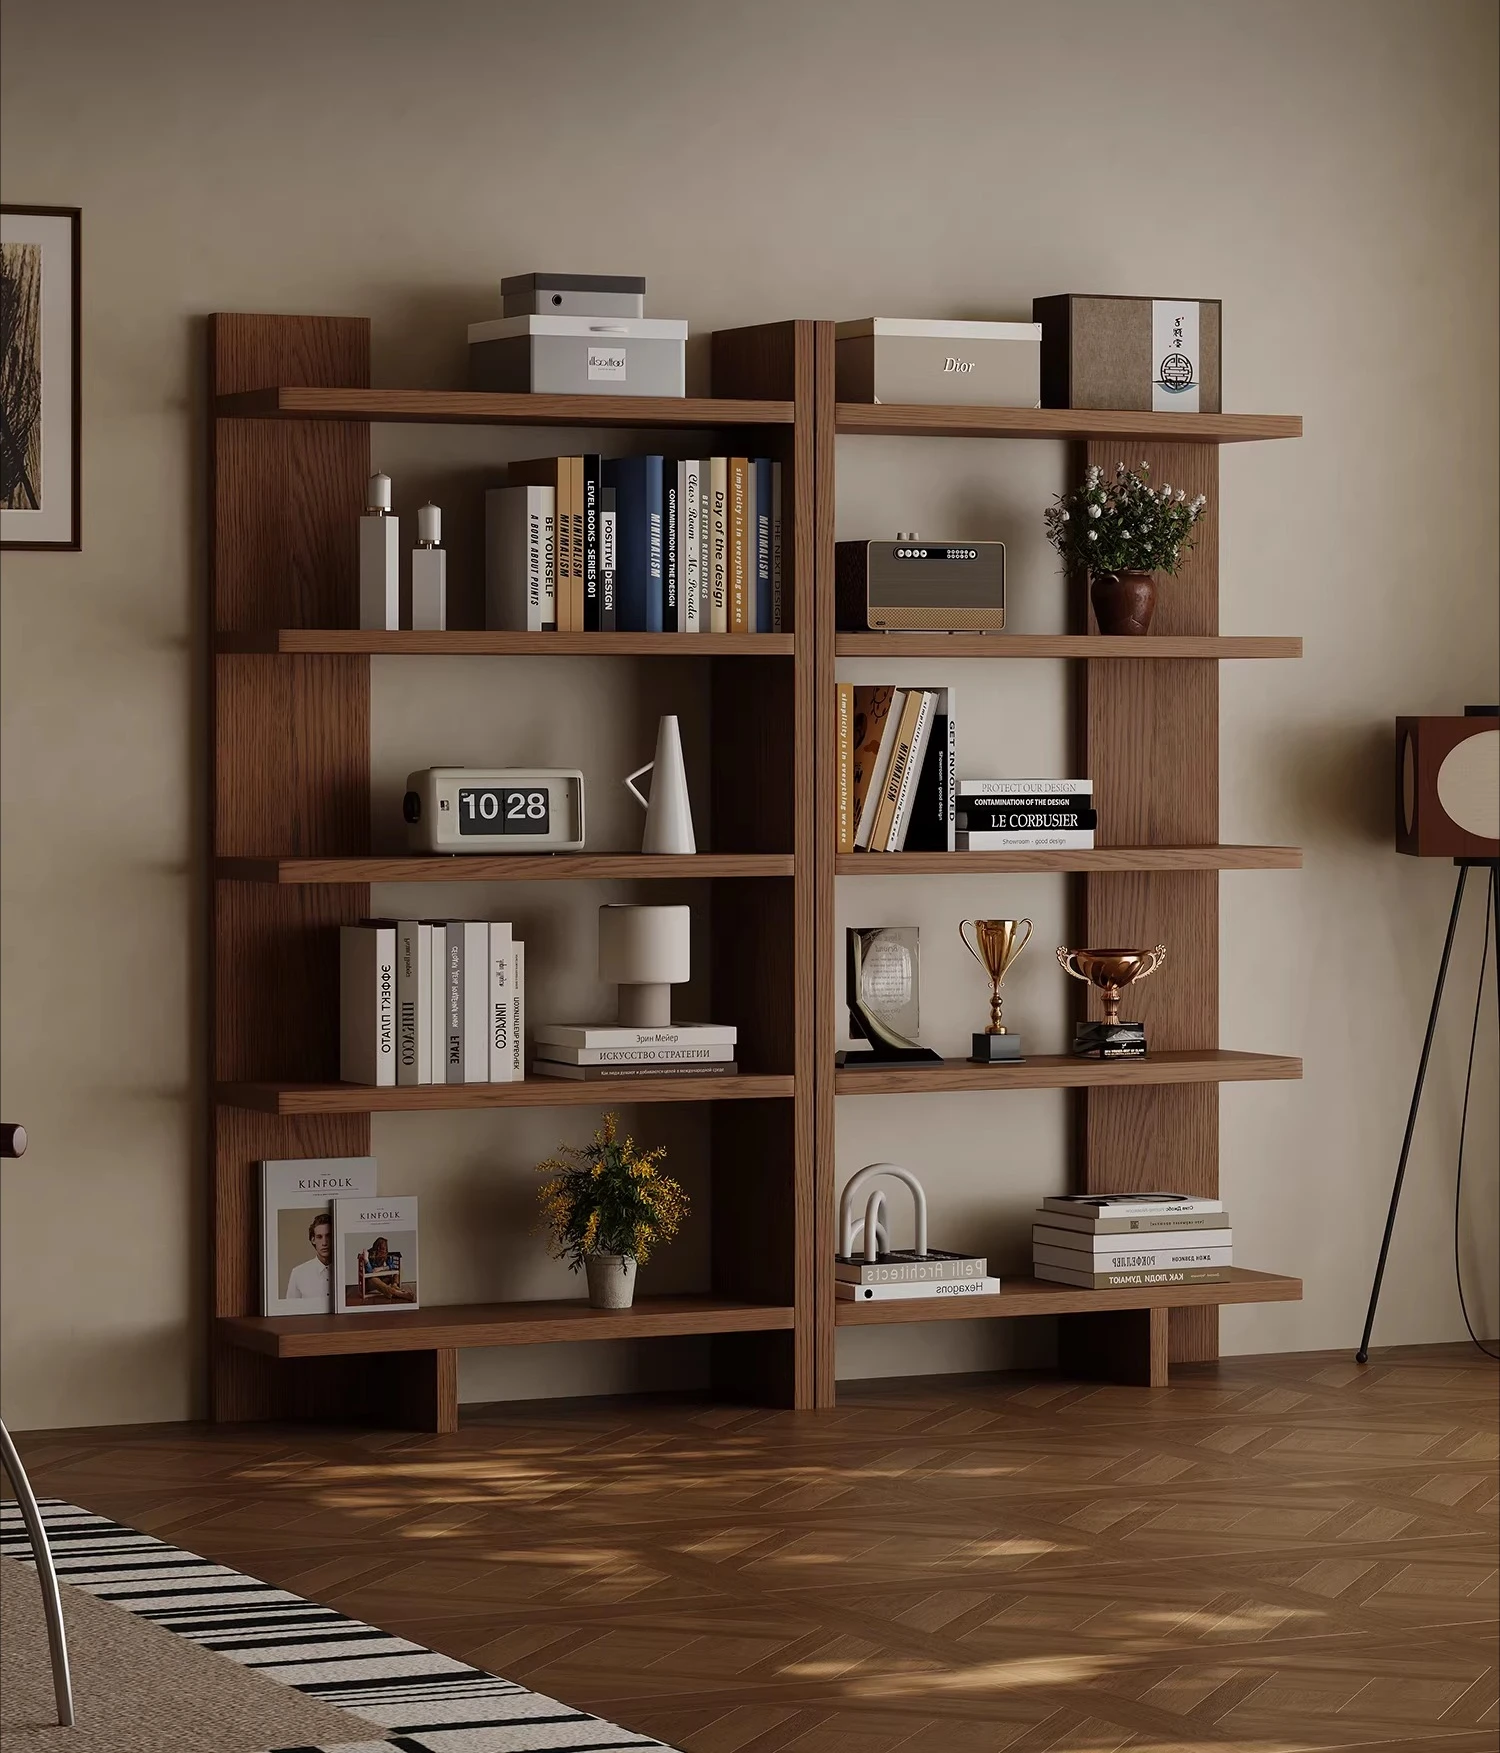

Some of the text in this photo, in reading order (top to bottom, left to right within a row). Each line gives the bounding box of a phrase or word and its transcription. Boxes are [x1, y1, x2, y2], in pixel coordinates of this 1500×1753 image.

[944, 358, 975, 372] Dior
[688, 474, 697, 504] Class
[702, 495, 708, 505] BE
[546, 516, 553, 532] BE
[688, 507, 697, 540] Room
[735, 528, 741, 537] in
[560, 514, 569, 578] MINIMALISM
[573, 514, 582, 578] MINIMALISM
[651, 514, 660, 578] MINIMALISM
[713, 491, 724, 608] Day of the design
[759, 516, 768, 579] MINIMALISM
[669, 552, 676, 561] OF
[688, 554, 697, 575] Ms.
[688, 578, 697, 620] Posada
[735, 593, 741, 605] we
[914, 701, 927, 743] simplicity
[841, 752, 848, 760] in
[909, 755, 915, 764] in
[887, 742, 908, 802] MINIMALISM
[899, 766, 912, 811] everything
[982, 783, 1076, 793] PROTECT OUR DESIGN
[462, 793, 498, 819] 10
[507, 793, 546, 819] 28
[841, 814, 848, 825] we
[895, 814, 900, 825] we
[991, 814, 1078, 828] LE CORBUSIER
[636, 1034, 678, 1043] Эрин Мейер
[599, 1050, 710, 1060] ИСКУССТВО СТРАТЕГИИ
[299, 1178, 352, 1188] KINFOLK
